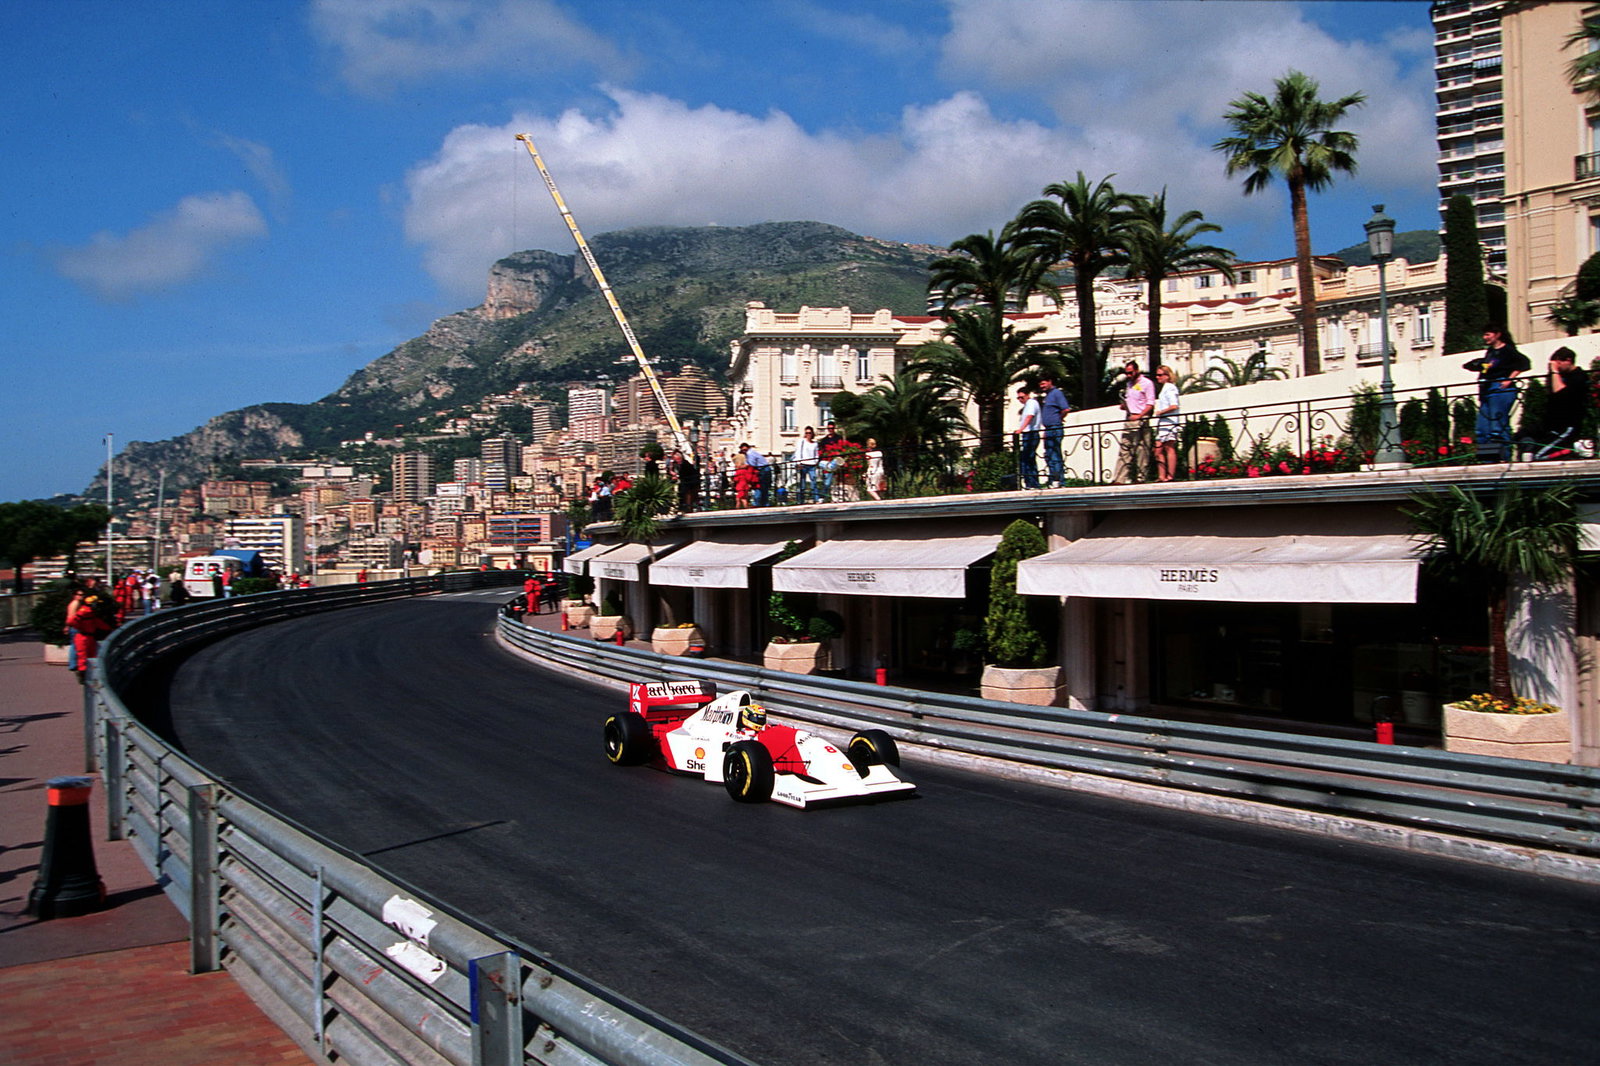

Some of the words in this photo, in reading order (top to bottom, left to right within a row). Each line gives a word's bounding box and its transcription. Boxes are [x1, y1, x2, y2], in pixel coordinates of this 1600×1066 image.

[1069, 309, 1129, 319] HITAGE
[1160, 568, 1218, 582] HERMÈS
[648, 682, 696, 696] arlboro
[824, 745, 837, 754] 8
[686, 759, 706, 771] She
